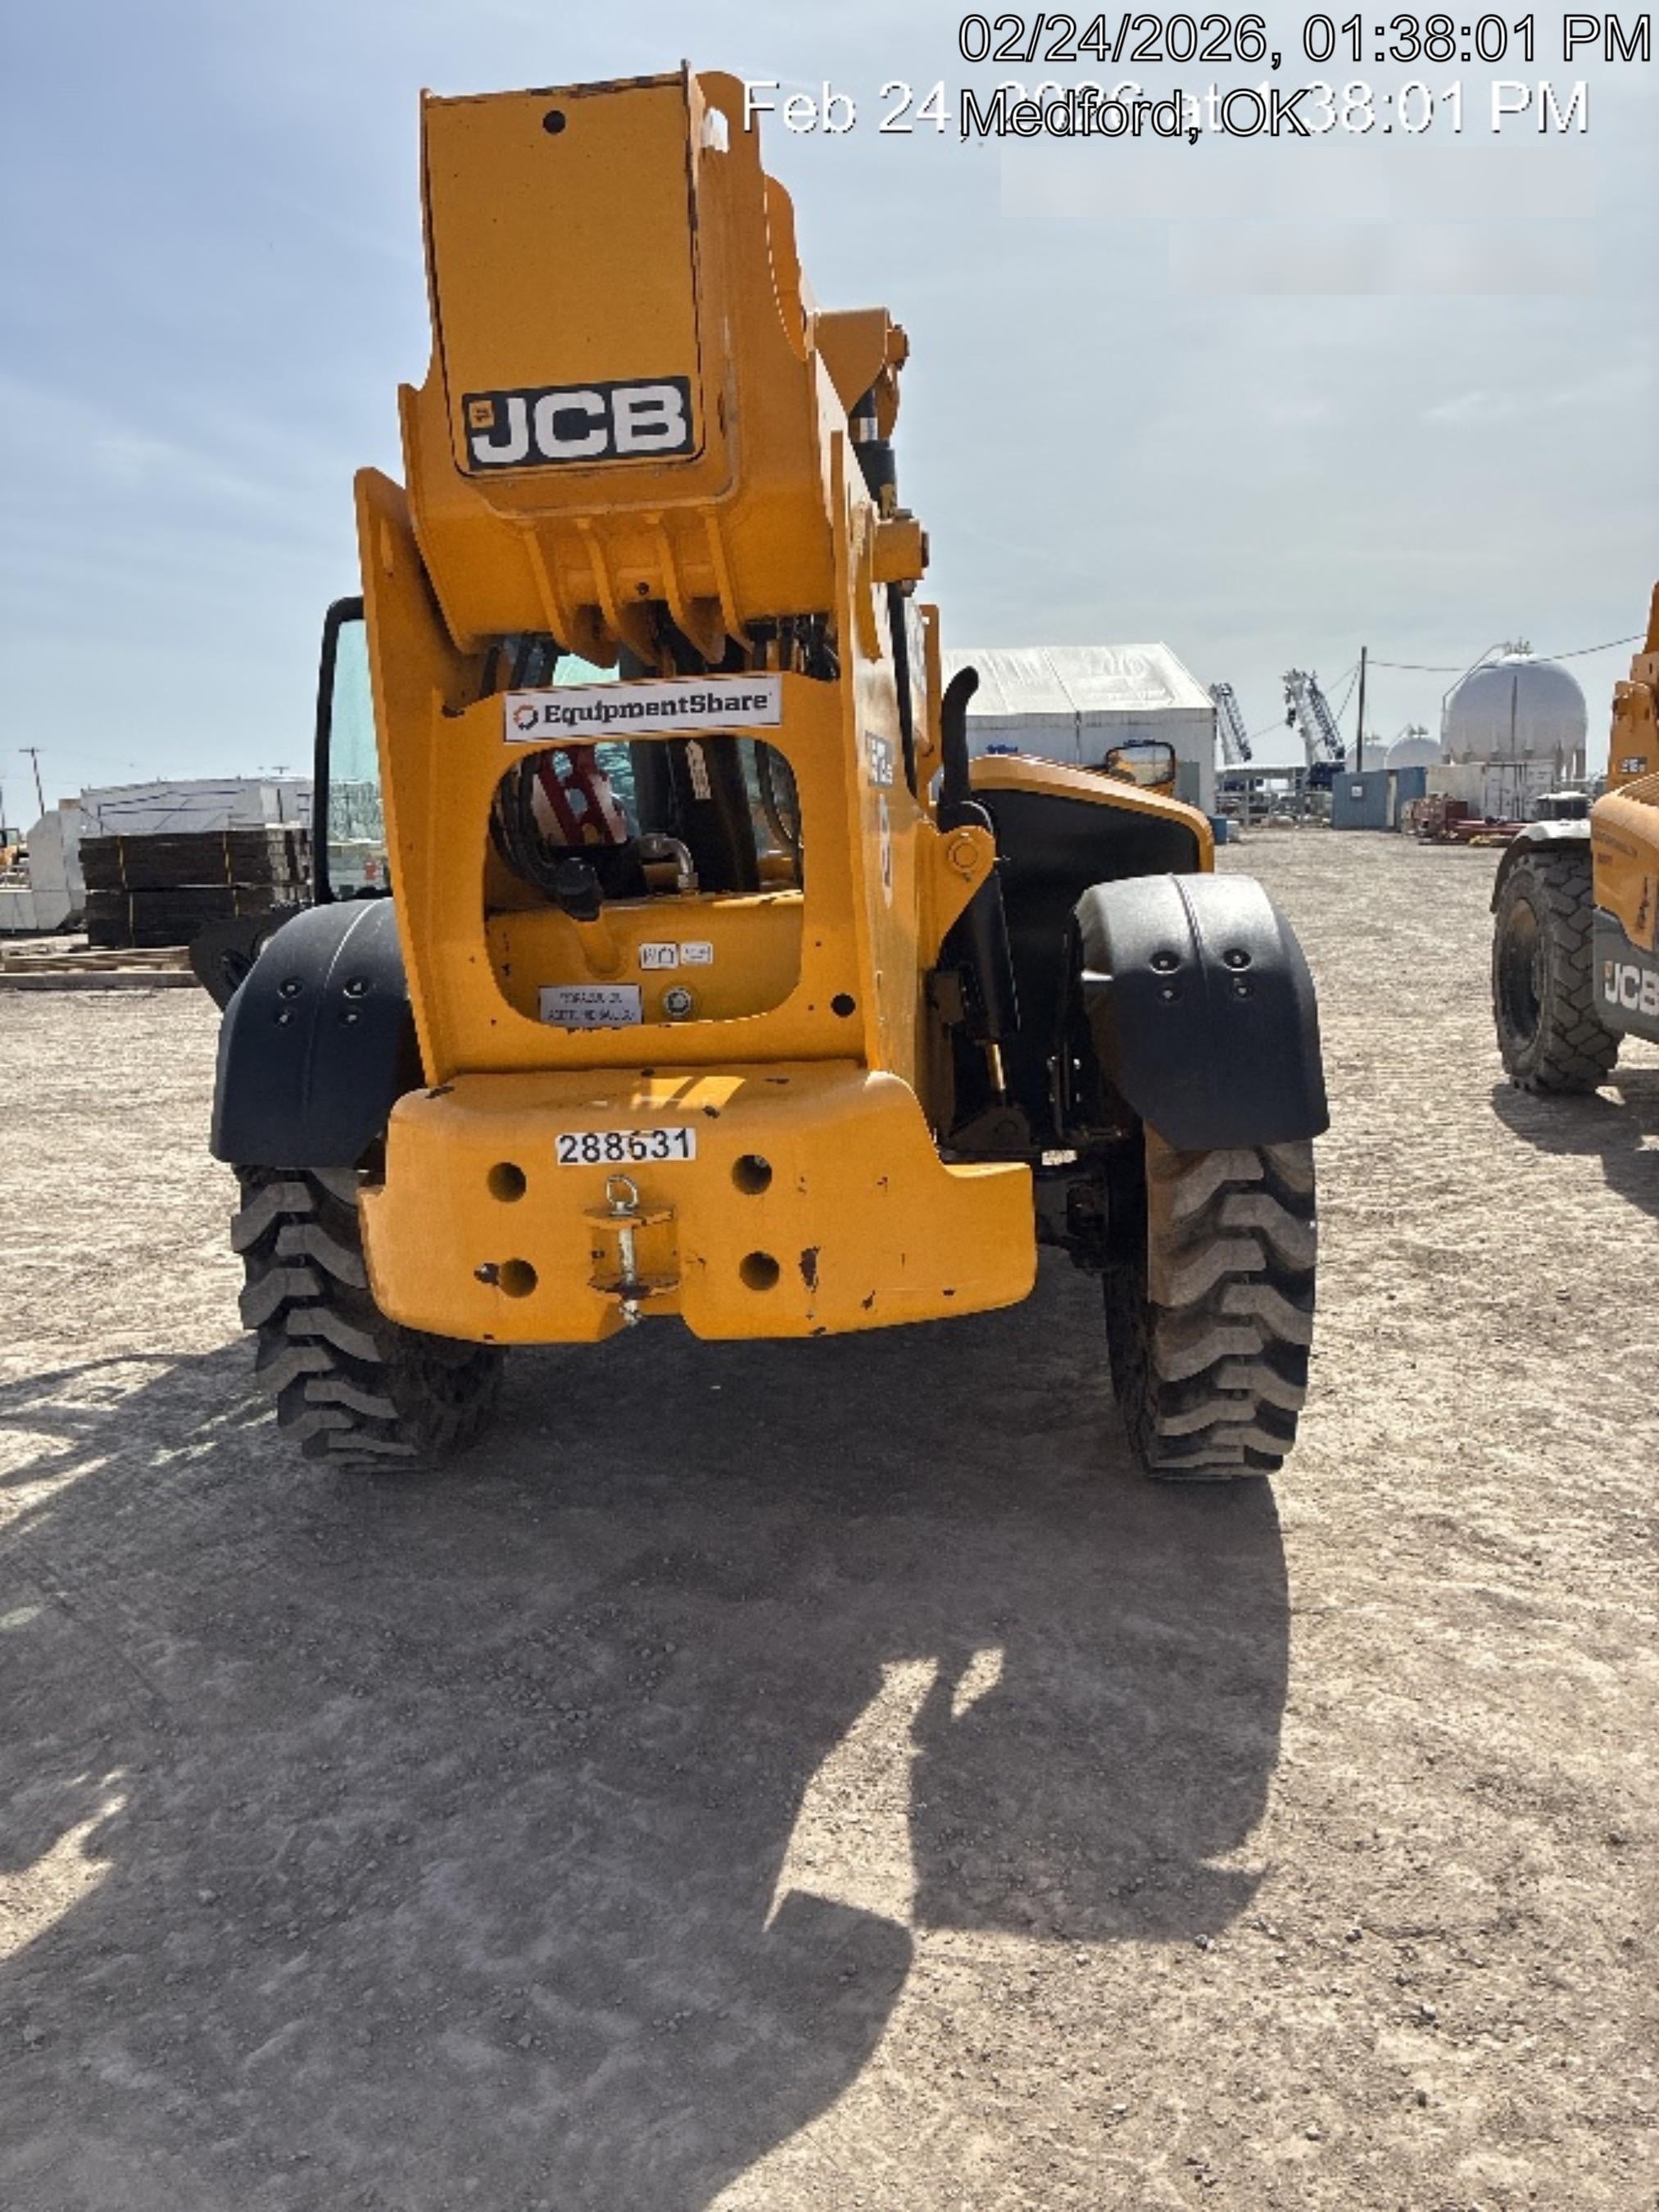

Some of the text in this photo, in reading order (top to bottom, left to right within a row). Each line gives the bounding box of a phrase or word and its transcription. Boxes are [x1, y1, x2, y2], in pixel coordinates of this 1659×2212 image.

[471, 385, 687, 463] JCB
[543, 692, 768, 727] EquipmentShare
[1604, 962, 1659, 1016] JCB
[559, 1127, 689, 1163] 288631
